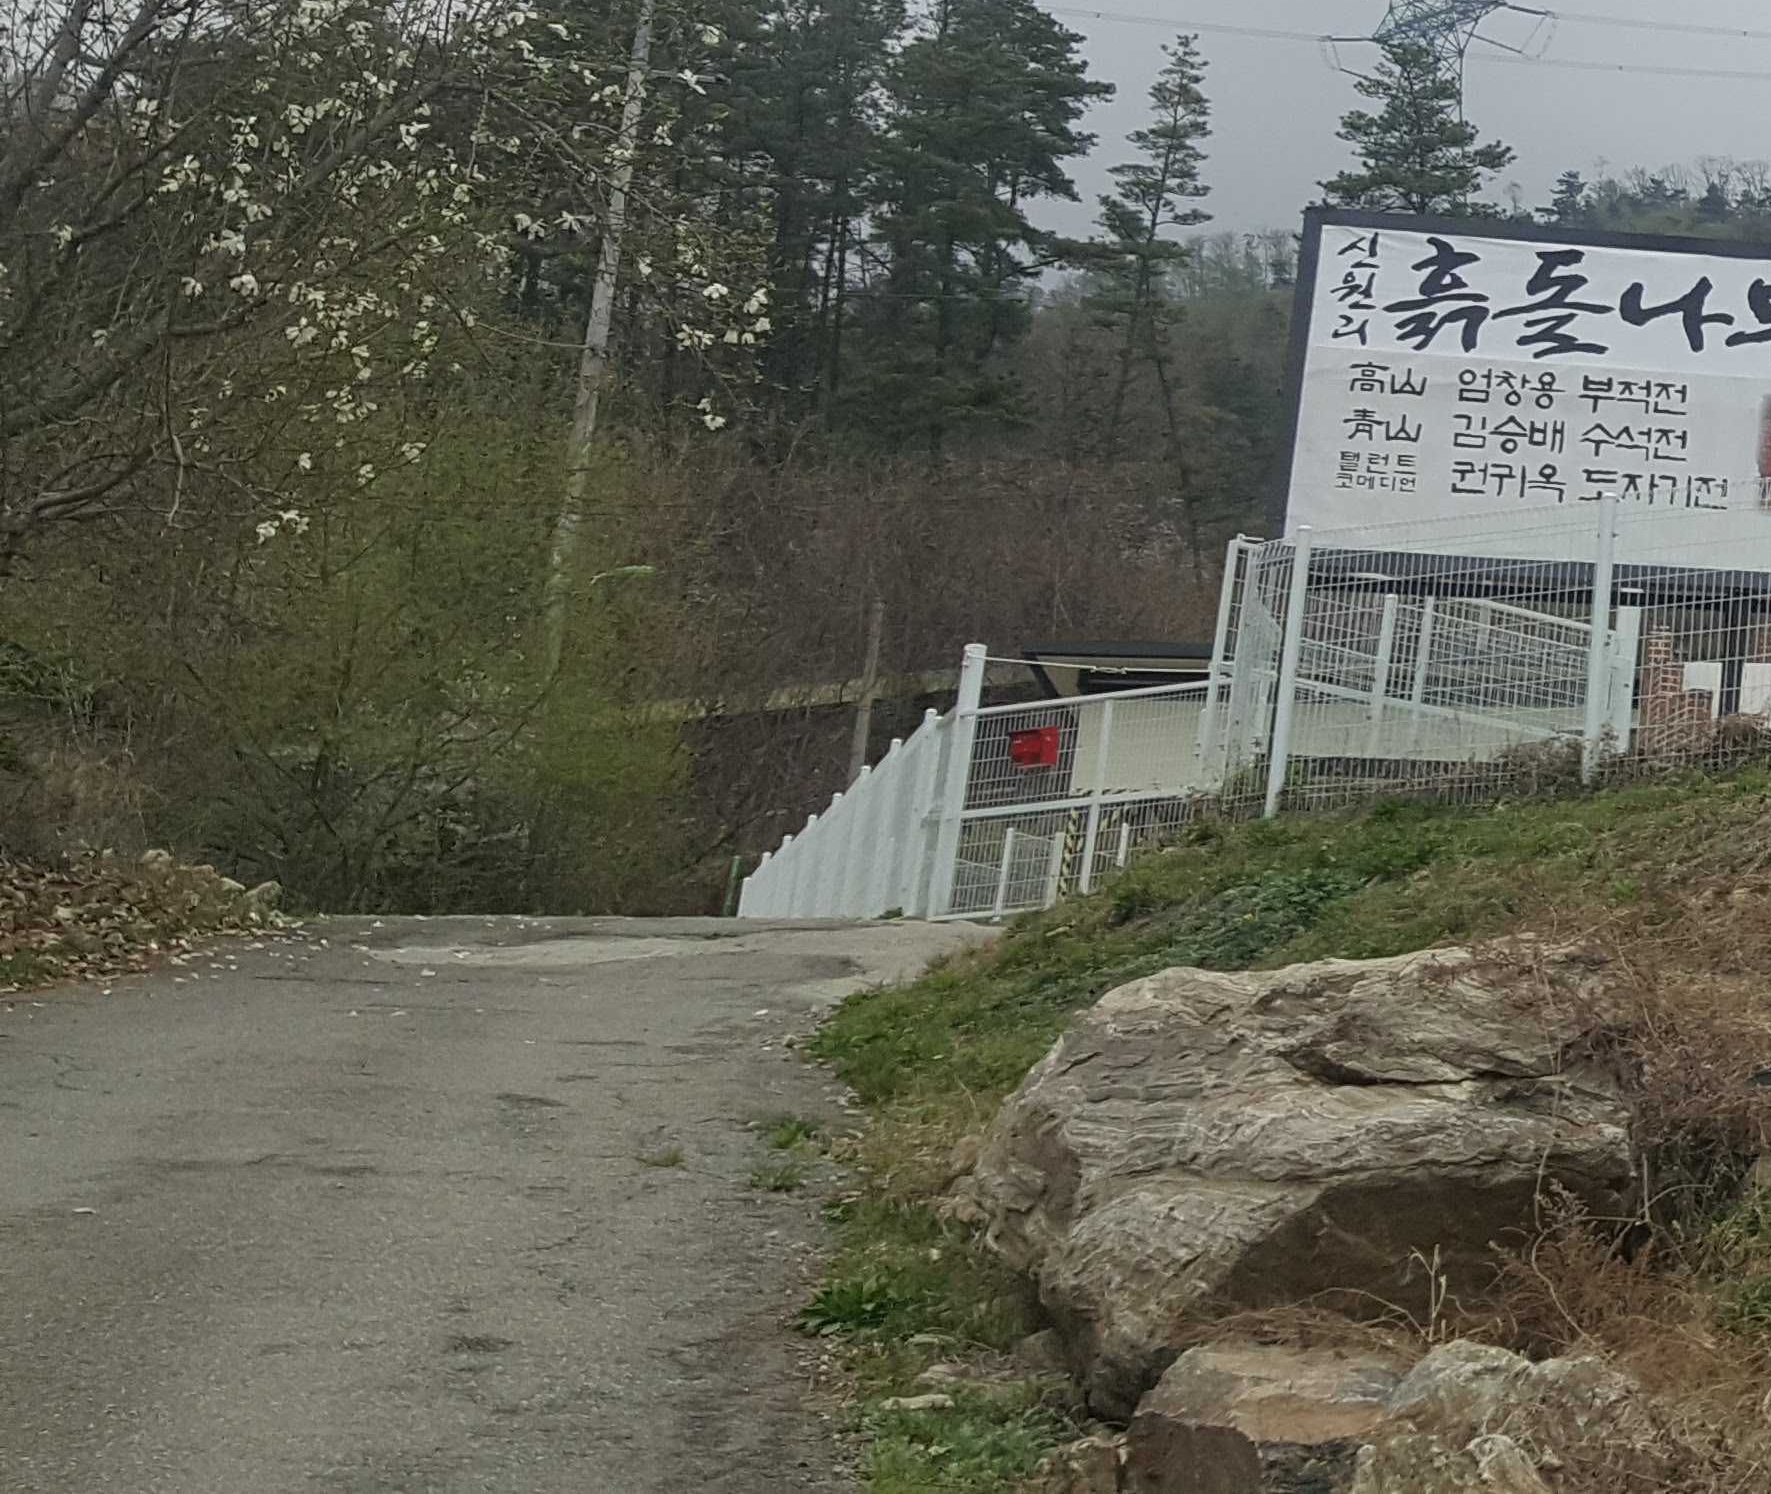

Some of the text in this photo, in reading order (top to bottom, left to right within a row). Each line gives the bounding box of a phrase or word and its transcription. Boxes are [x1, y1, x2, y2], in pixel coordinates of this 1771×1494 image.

[1329, 231, 1380, 346] 신원리
[1348, 361, 1688, 416] 高山 엄창용 부적전
[1451, 413, 1566, 455] 김승배
[1579, 422, 1688, 463] 수석전
[1333, 472, 1417, 493] 코메디언
[1451, 460, 1728, 511] 권귀옥 도자기전
